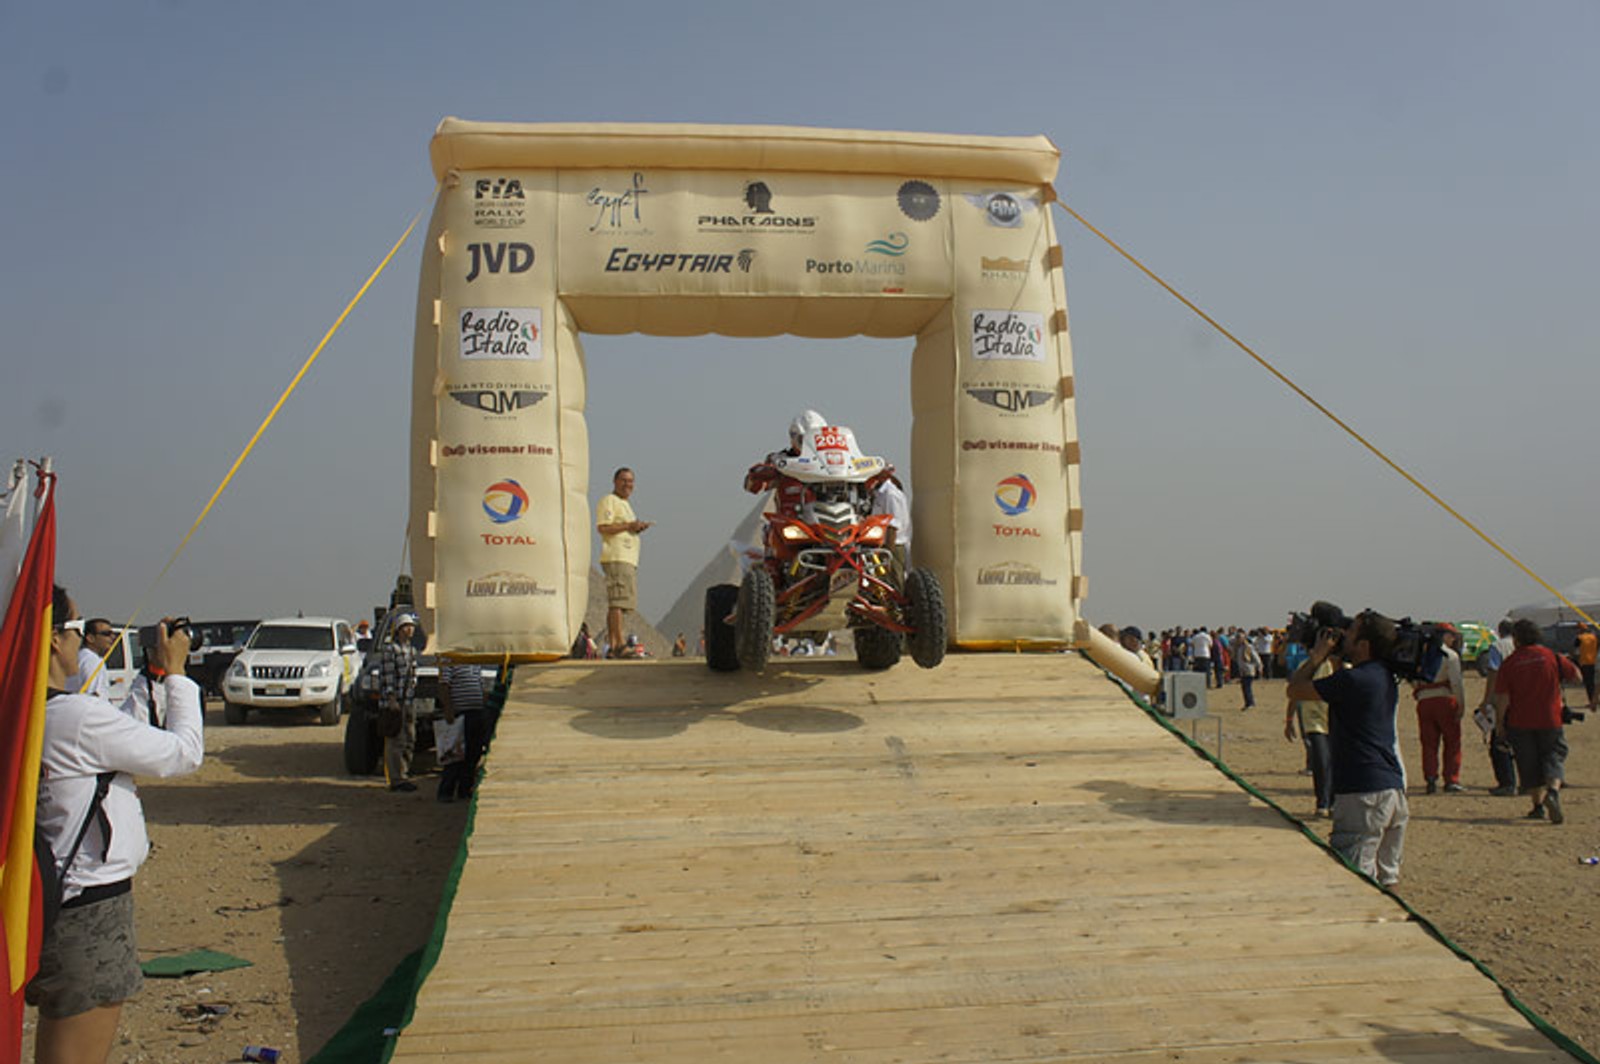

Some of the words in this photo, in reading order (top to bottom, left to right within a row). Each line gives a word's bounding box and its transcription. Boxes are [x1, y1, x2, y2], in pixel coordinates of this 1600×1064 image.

[698, 216, 816, 227] PHARAONS
[466, 242, 535, 283] JVD
[461, 310, 520, 333] Radio
[973, 313, 1027, 335] Radio
[463, 333, 529, 355] Italia
[974, 333, 1036, 357] Italia
[468, 444, 525, 456] visemar
[528, 444, 554, 456] line
[480, 533, 536, 545] TOTAL
[992, 524, 1040, 537] TOTAL
